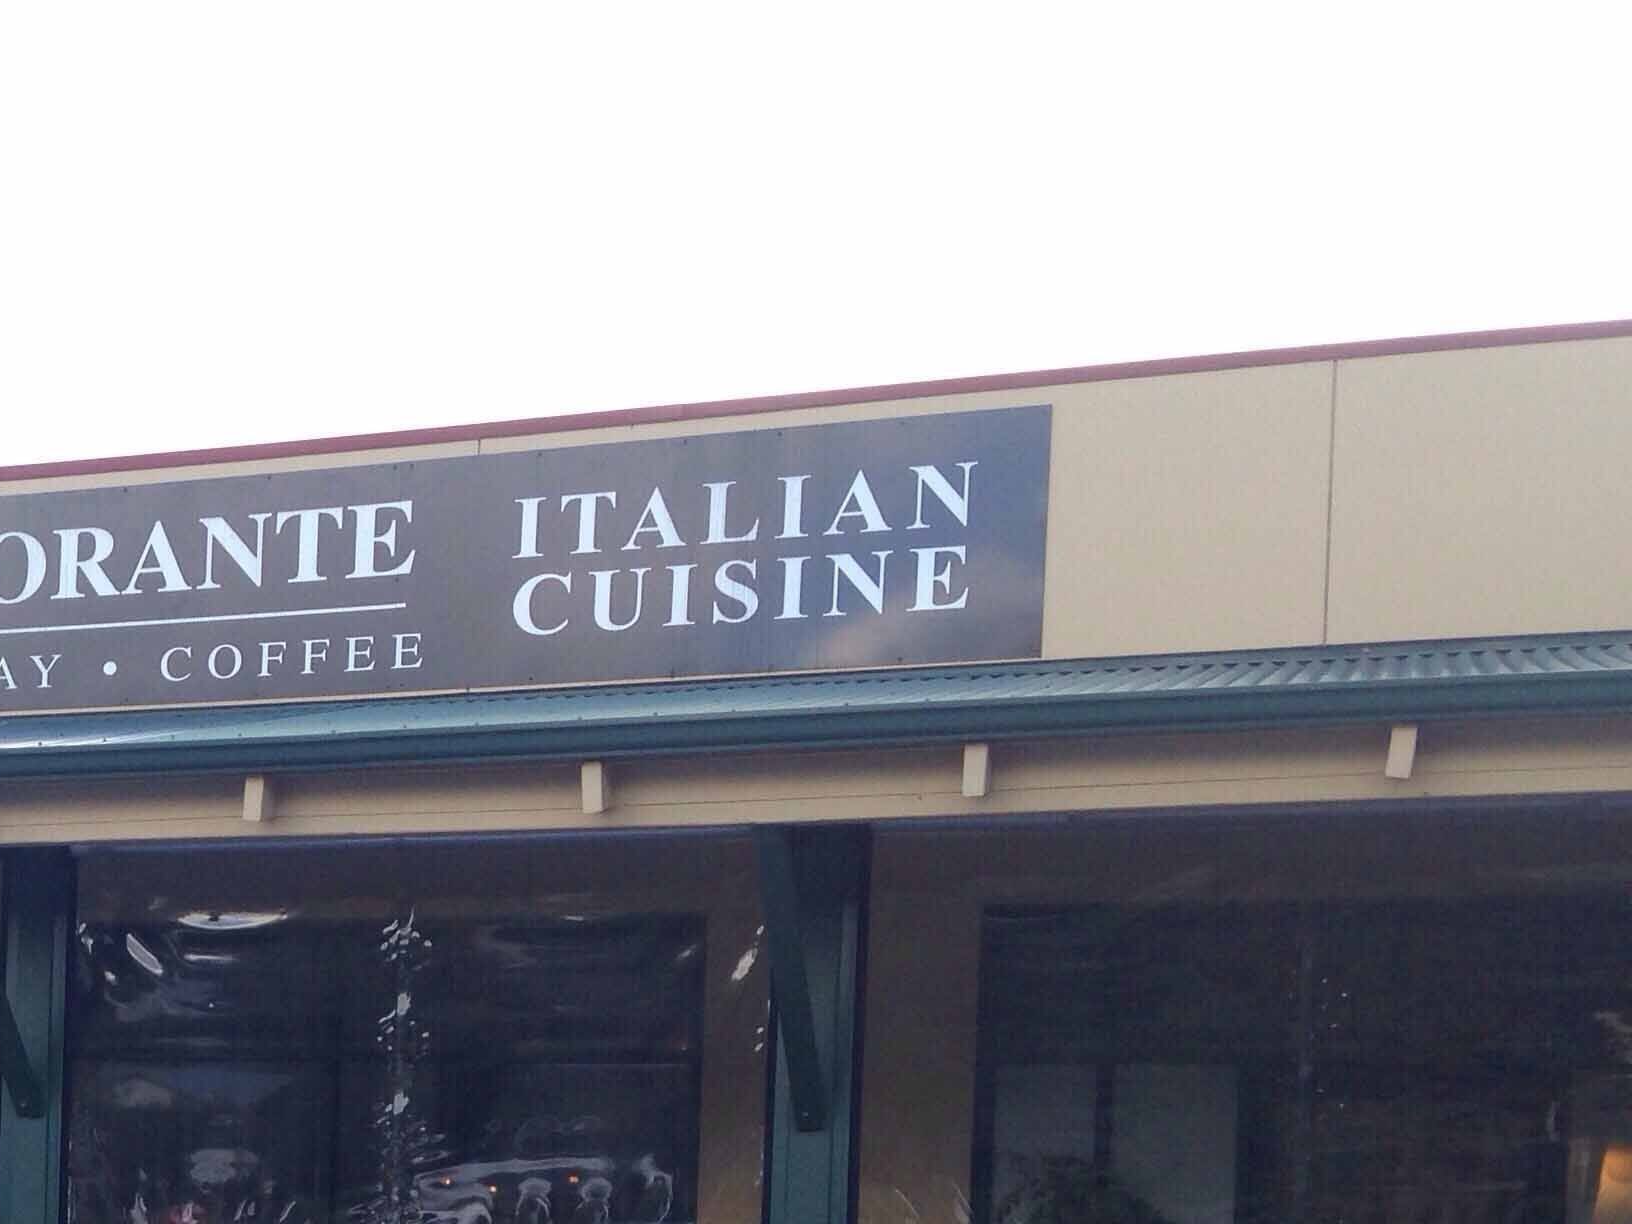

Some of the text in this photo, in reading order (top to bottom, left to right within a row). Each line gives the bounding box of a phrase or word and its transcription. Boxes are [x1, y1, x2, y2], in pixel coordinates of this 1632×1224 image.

[512, 460, 978, 560] ITALIAN
[512, 544, 969, 636] CUISINE
[159, 632, 424, 683] COFFEE
